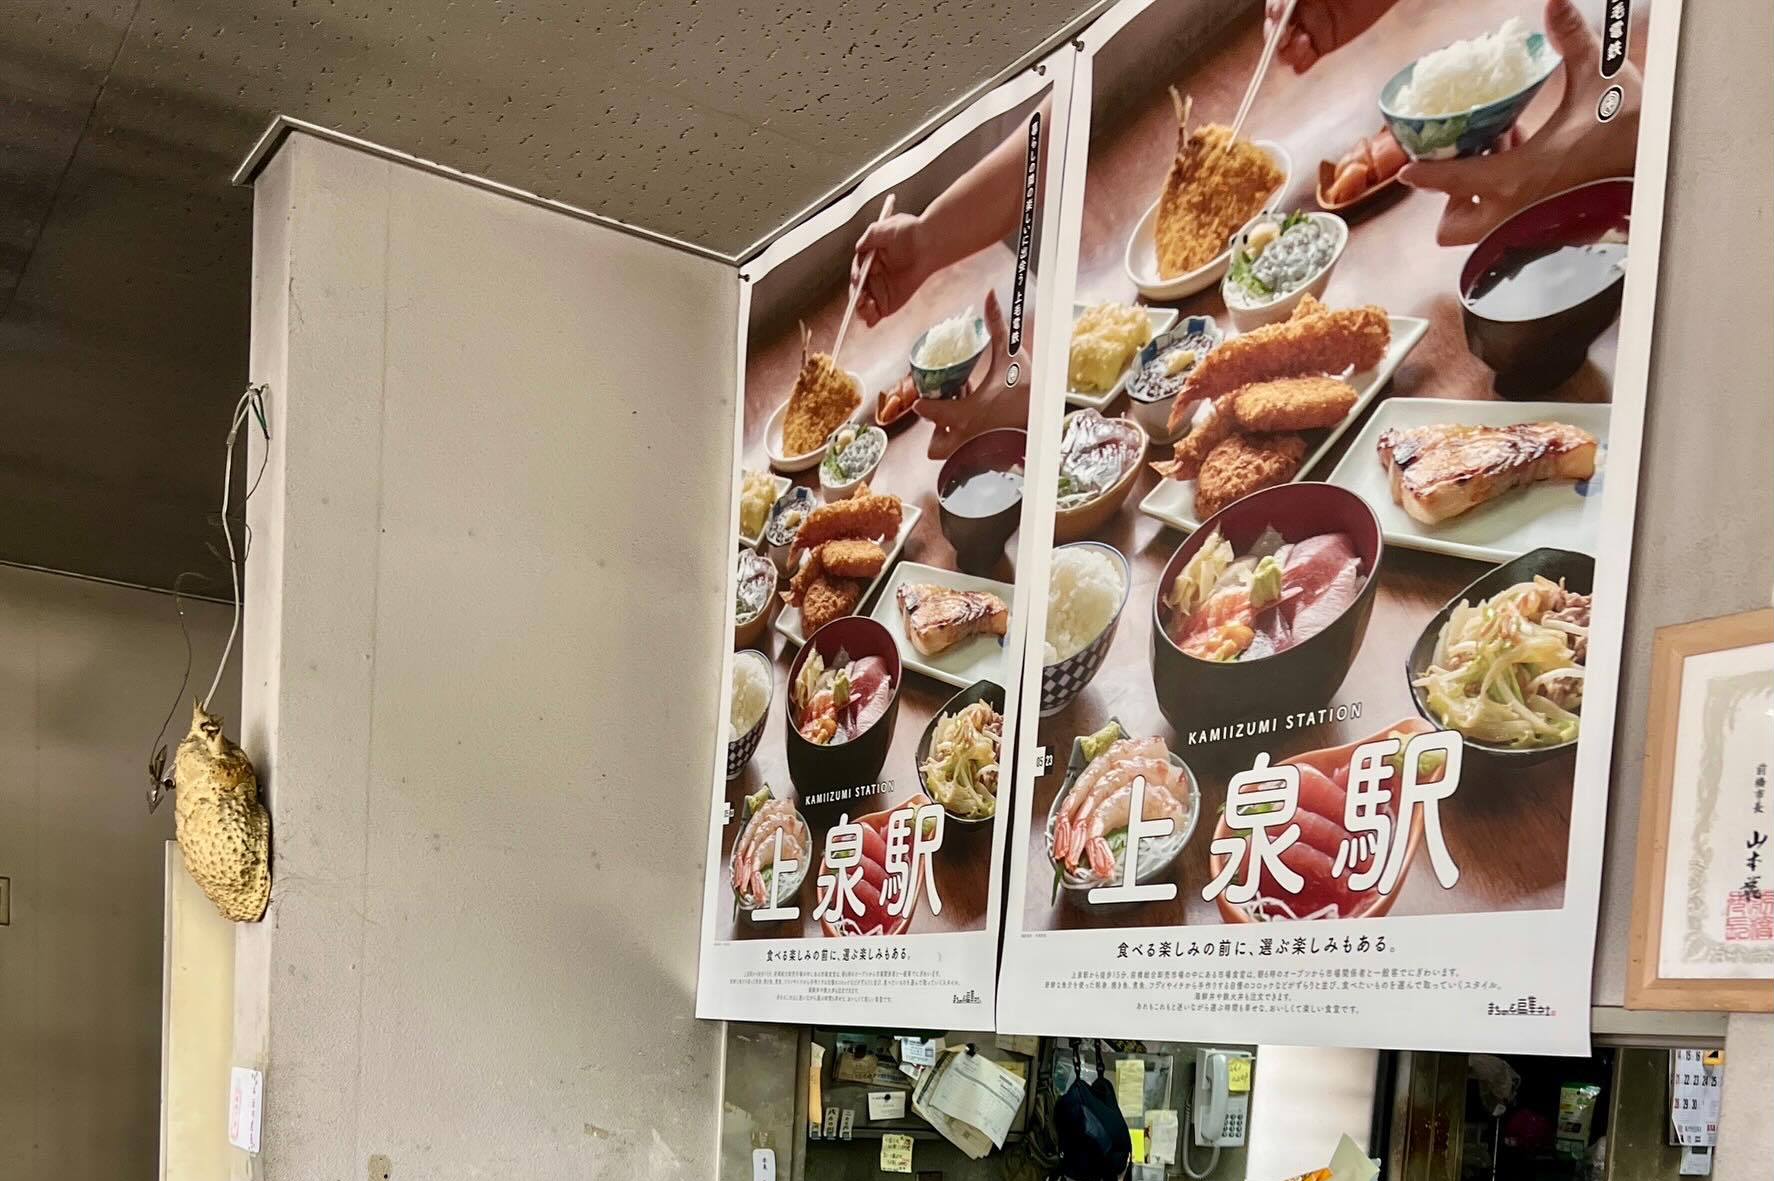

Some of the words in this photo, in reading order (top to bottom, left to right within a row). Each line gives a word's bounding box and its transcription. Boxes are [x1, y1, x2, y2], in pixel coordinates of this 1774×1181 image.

[1188, 715, 1277, 746] KAMIIZUMI
[1285, 702, 1363, 730] STATION
[804, 786, 851, 807] KAMIIZUMI
[855, 779, 895, 797] STATION
[1087, 729, 1464, 906] 上泉駅
[750, 803, 945, 924] 上泉駅
[1116, 934, 1396, 959] 食べる楽しみの前に、選ぶ楽しみもある。
